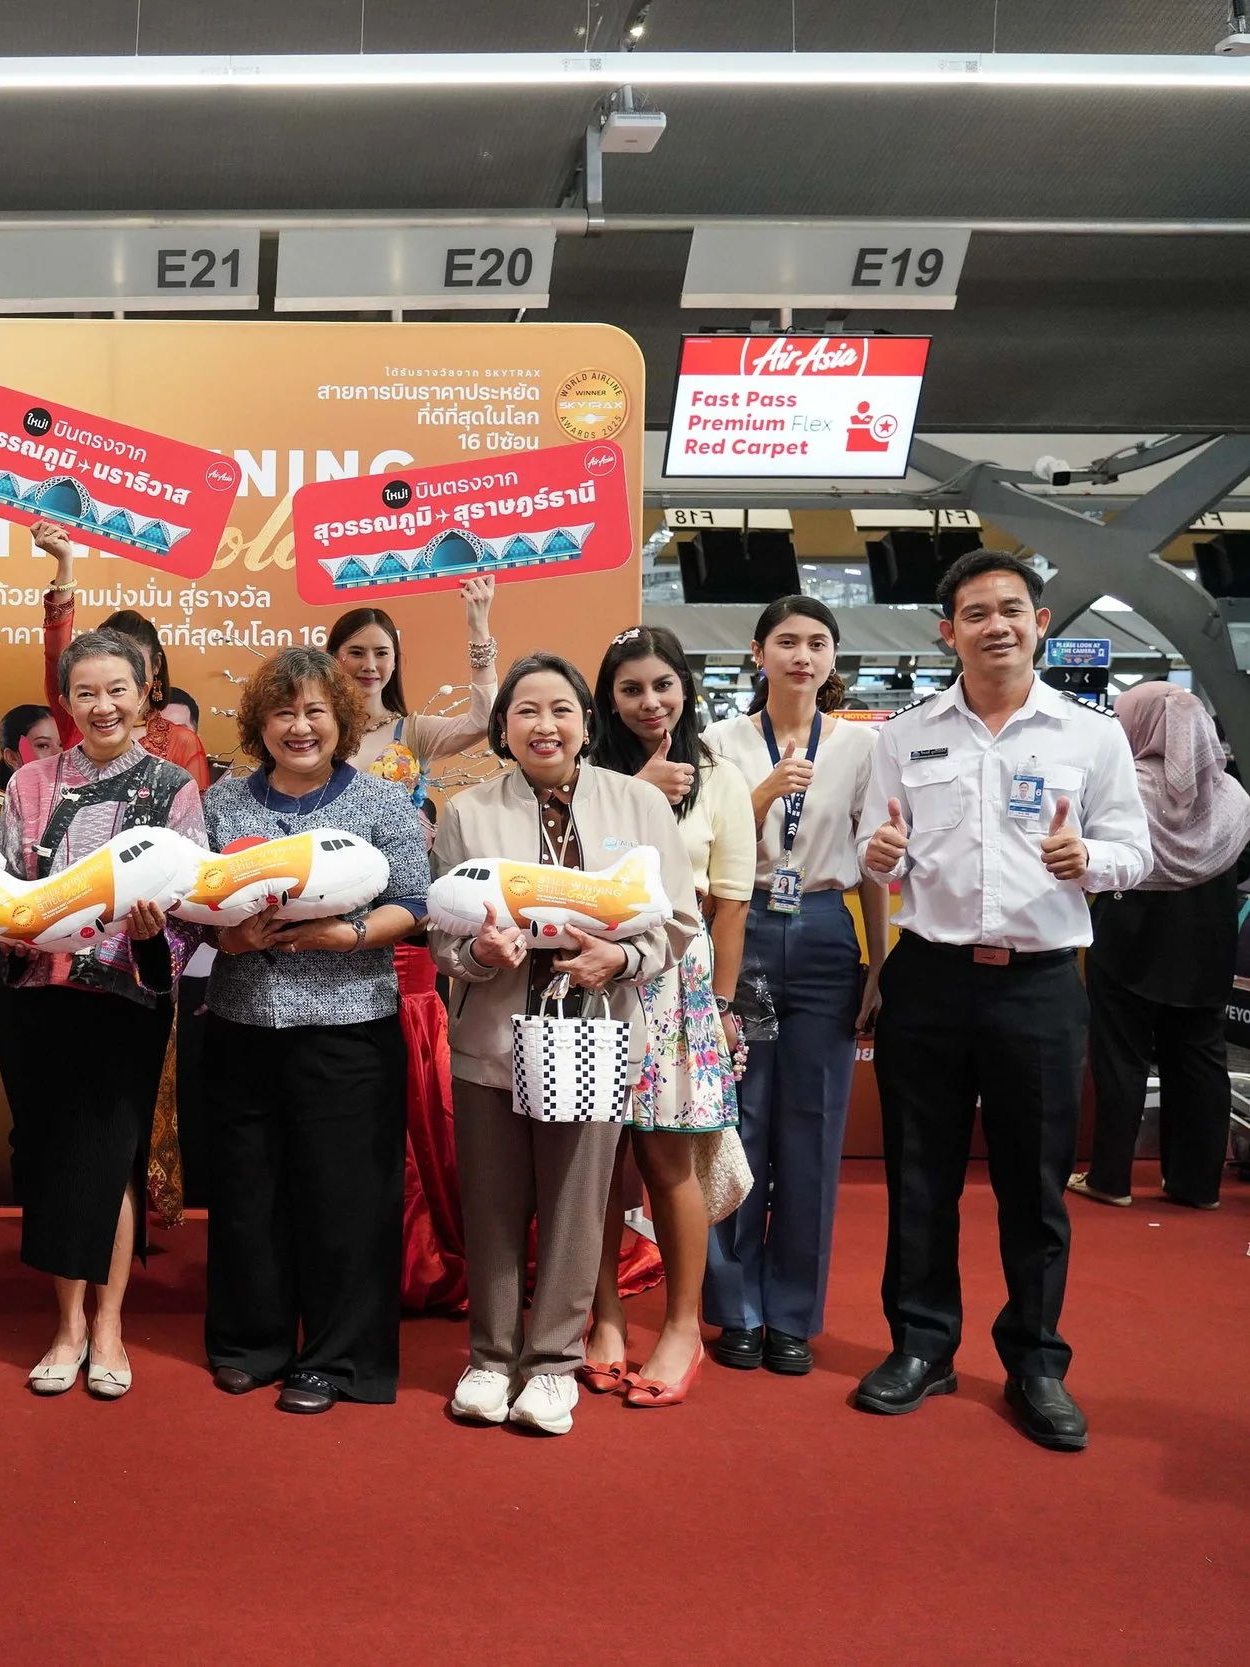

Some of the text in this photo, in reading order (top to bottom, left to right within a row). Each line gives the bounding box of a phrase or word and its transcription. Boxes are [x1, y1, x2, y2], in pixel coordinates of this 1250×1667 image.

[157, 249, 241, 290] E21
[444, 248, 534, 289] E20
[852, 247, 945, 289] E19
[753, 337, 858, 376] AirAsia
[384, 366, 541, 378] ได้รับรางวัลจาก SKYTRAX
[317, 382, 541, 401] สายการบินราคาประหยัด
[560, 372, 623, 398] WORLD AIRLINE
[558, 401, 624, 410] SKYTRAX
[691, 390, 798, 408] Fast Pass
[417, 404, 541, 431] ที่ดีที่สุดในโลก
[560, 415, 622, 439] AWARDS 2025
[687, 413, 833, 433] Premium Flex
[26, 412, 148, 464] ใหม่! บินตรงจาก
[457, 430, 540, 451] 16 ปีซ้อน
[684, 438, 809, 459] Red Carpet
[93, 461, 192, 506] นราธิวาส
[384, 470, 518, 502] ใหม่! บินตรงจาก
[312, 479, 597, 546] สุวรรณภูมิ สุราษฎร์ธานี
[178, 581, 272, 615] สู่รางวัล
[299, 625, 328, 647] 16
[537, 884, 566, 896] STILL
[571, 880, 622, 898] WINNING
